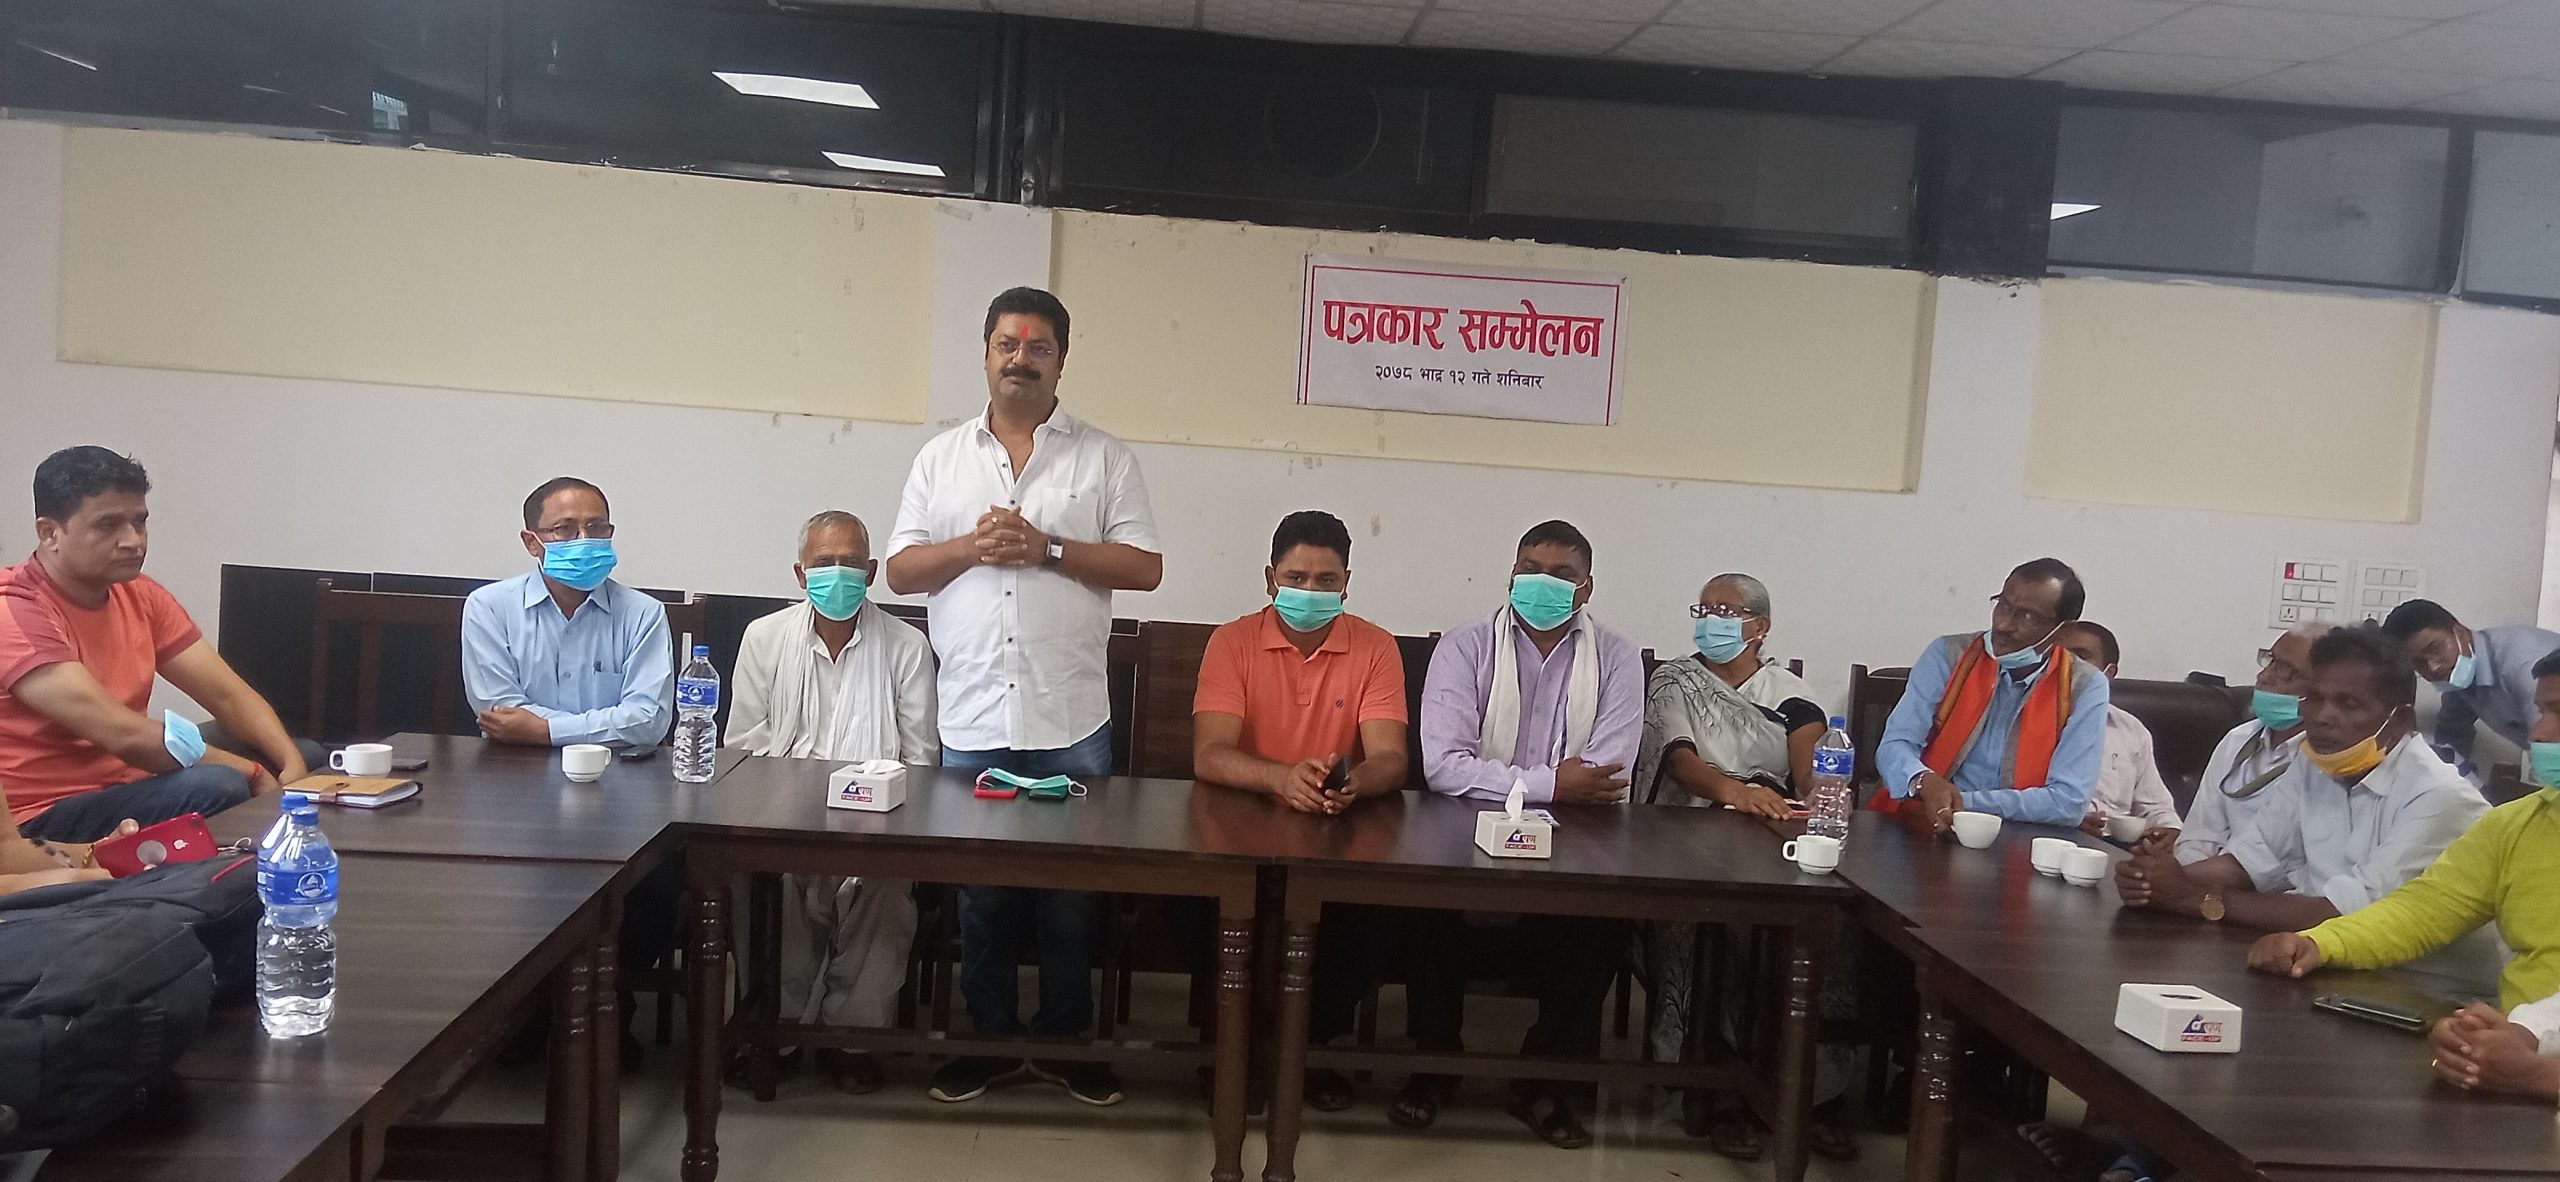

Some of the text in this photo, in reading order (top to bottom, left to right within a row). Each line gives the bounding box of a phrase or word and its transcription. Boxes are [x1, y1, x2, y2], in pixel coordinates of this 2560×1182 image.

[1323, 299, 1604, 357] पत्रकार सम्मेलन
[1375, 365, 1545, 389] २०७८ भाद्र १२ गते शनिवार
